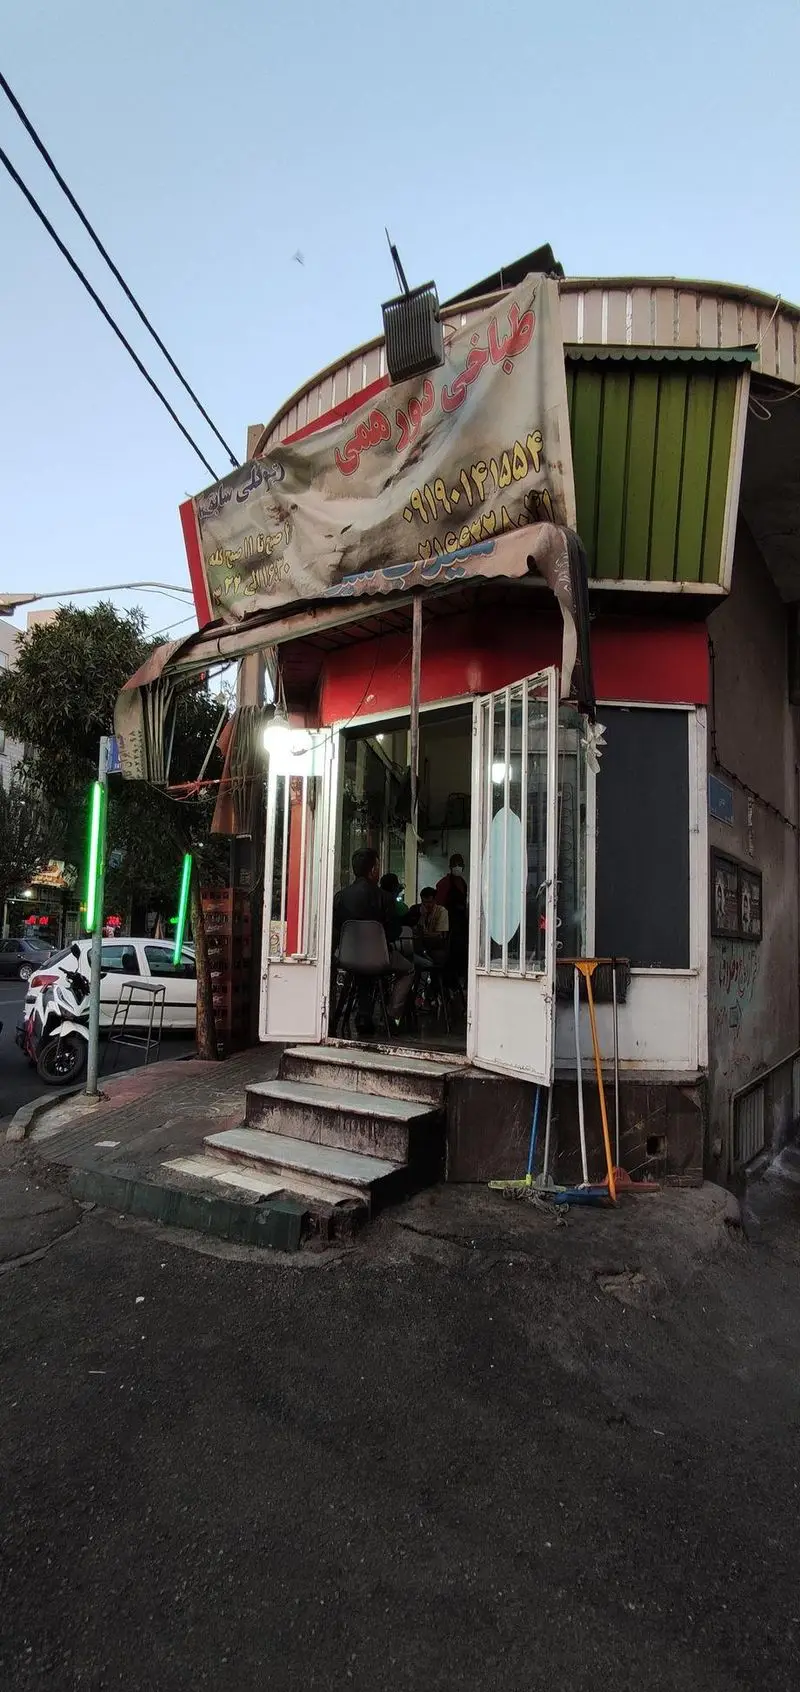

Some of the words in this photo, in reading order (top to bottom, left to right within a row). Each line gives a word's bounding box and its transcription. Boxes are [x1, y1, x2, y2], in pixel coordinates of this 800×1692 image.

[441, 302, 537, 414] طباخی
[333, 407, 393, 477] همی
[394, 378, 436, 454] دور
[402, 429, 544, 524] ۰۹۱۹۰۱۴۱۵۵۴
